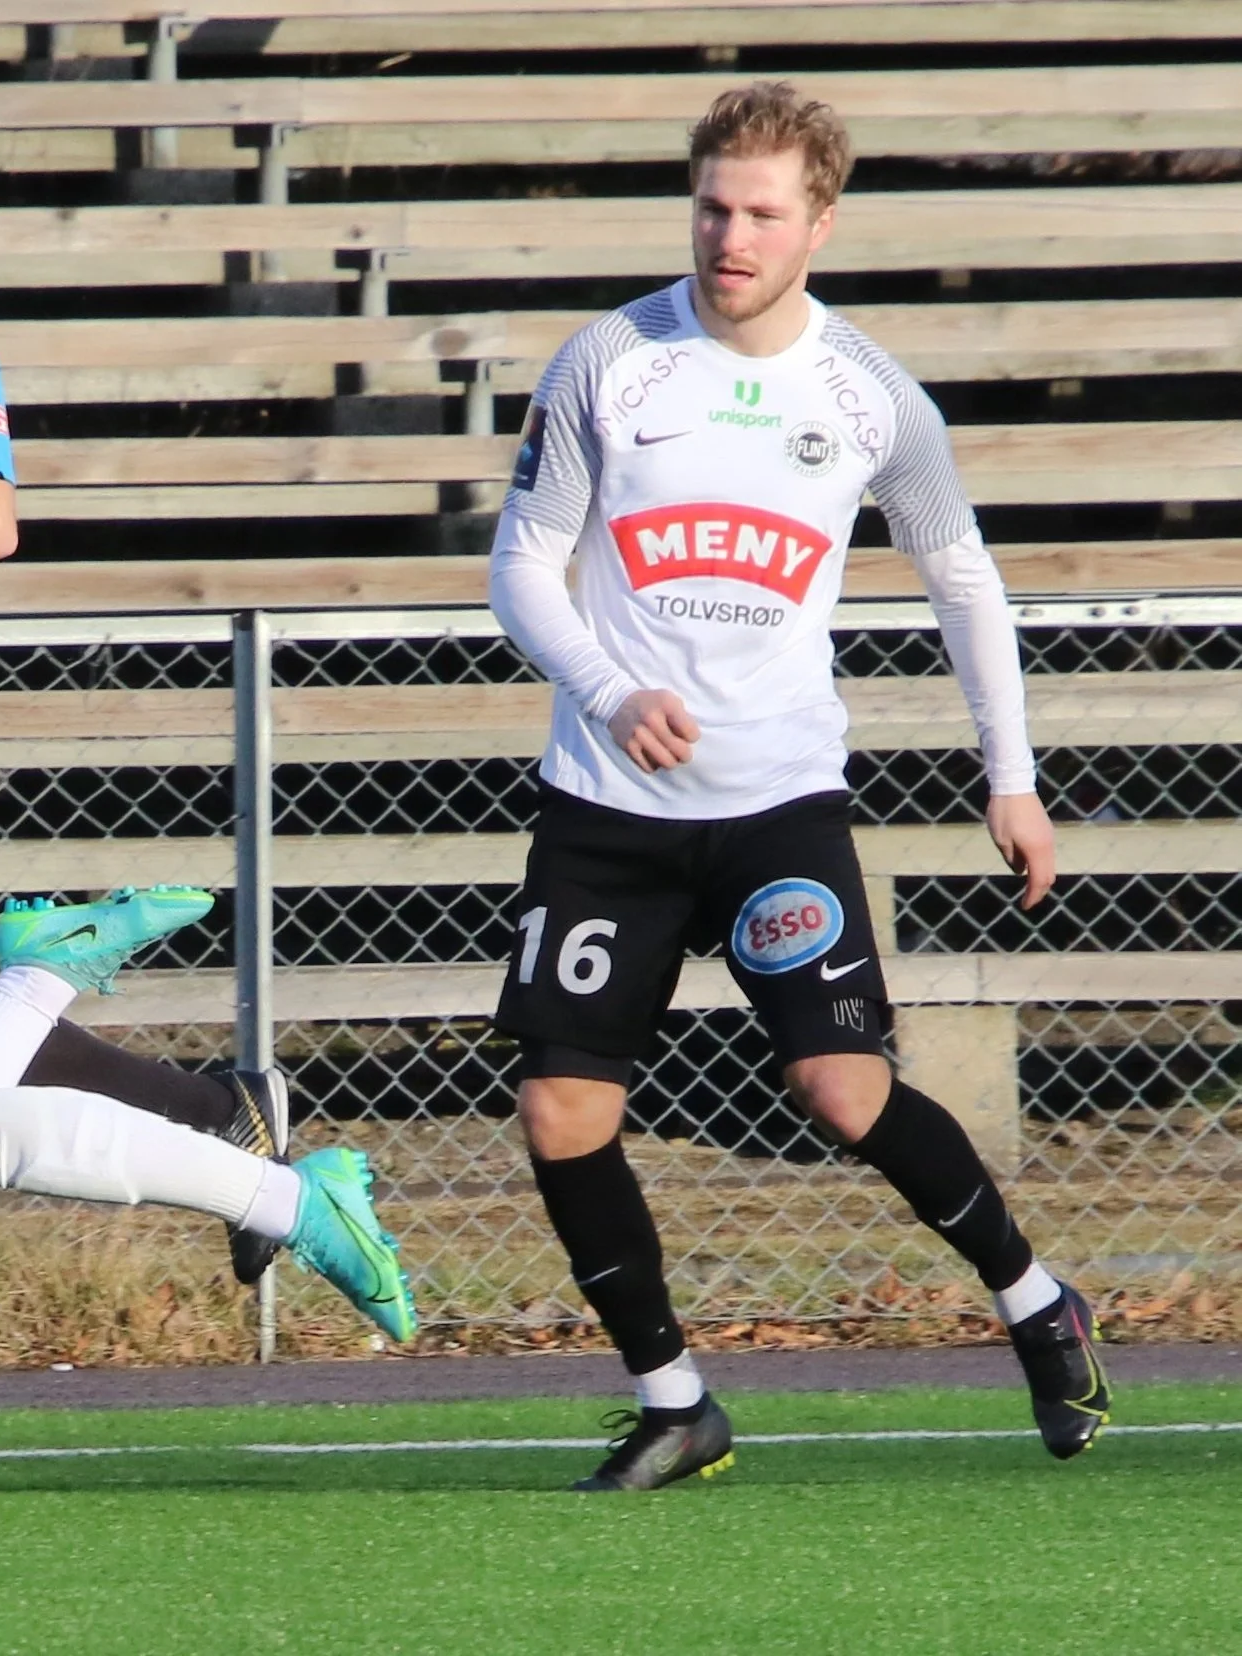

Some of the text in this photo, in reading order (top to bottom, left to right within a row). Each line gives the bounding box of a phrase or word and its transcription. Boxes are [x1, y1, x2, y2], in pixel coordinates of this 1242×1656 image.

[708, 407, 783, 430] unisport
[796, 437, 829, 461] FLINT
[635, 520, 814, 579] MENY
[654, 595, 785, 628] TOLVSRØD
[518, 905, 619, 995] 16
